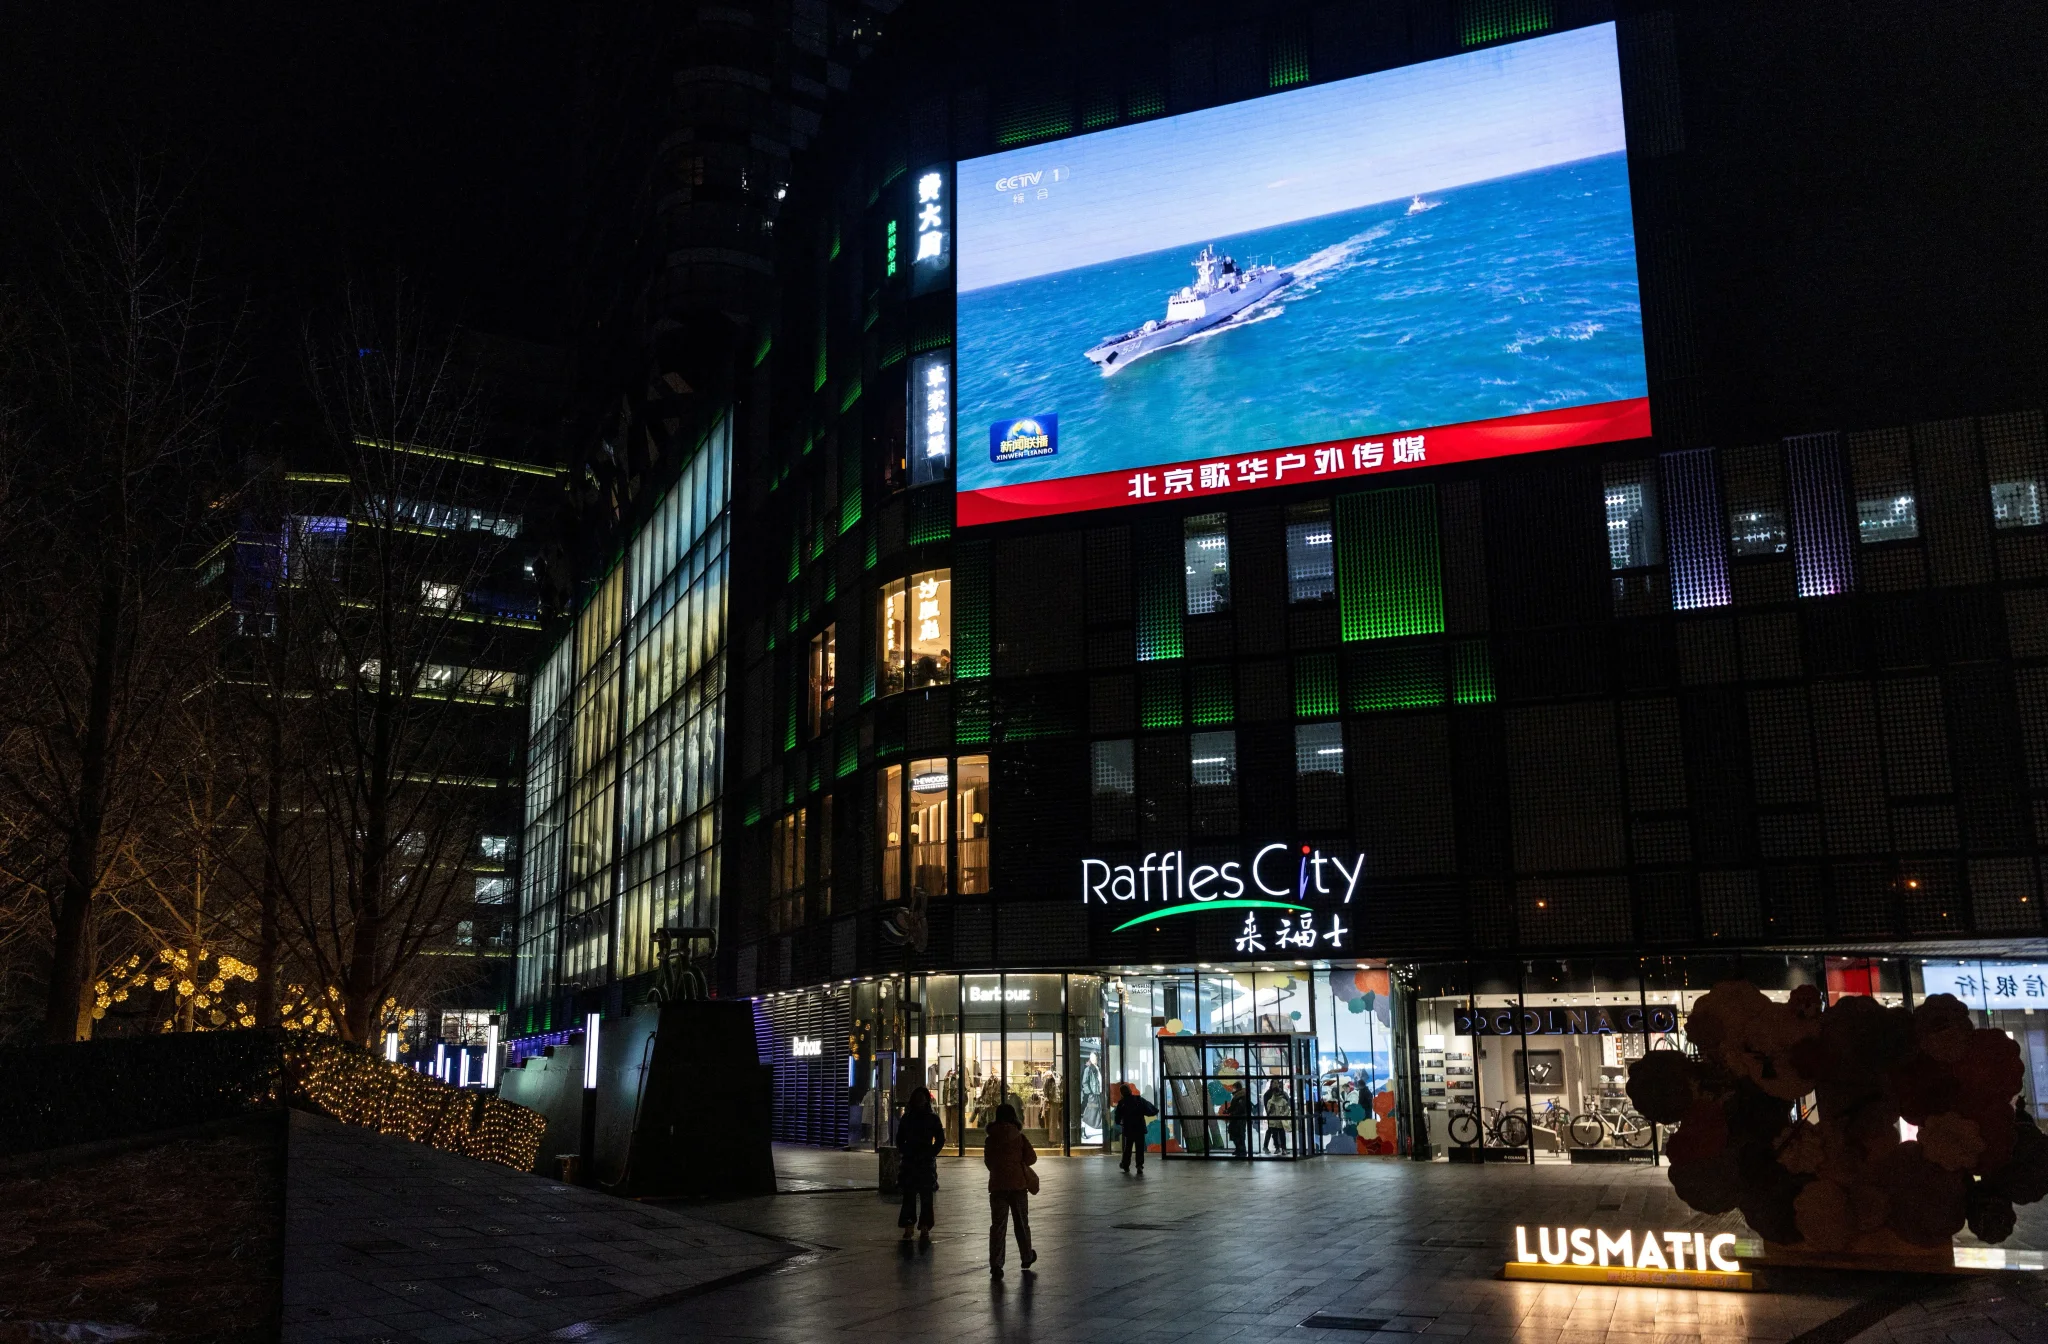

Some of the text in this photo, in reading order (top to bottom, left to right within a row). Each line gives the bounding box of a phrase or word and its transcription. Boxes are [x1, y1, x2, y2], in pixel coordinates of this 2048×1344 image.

[995, 169, 1043, 192] CCTV
[1012, 188, 1049, 205] 综合
[1000, 434, 1049, 453] 新闻联播
[1127, 434, 1427, 499] 北京歌华户外传媒
[1081, 843, 1365, 904] Raffles City
[1235, 911, 1348, 953] 来福士
[1515, 1225, 1741, 1272] LUSMATIC
